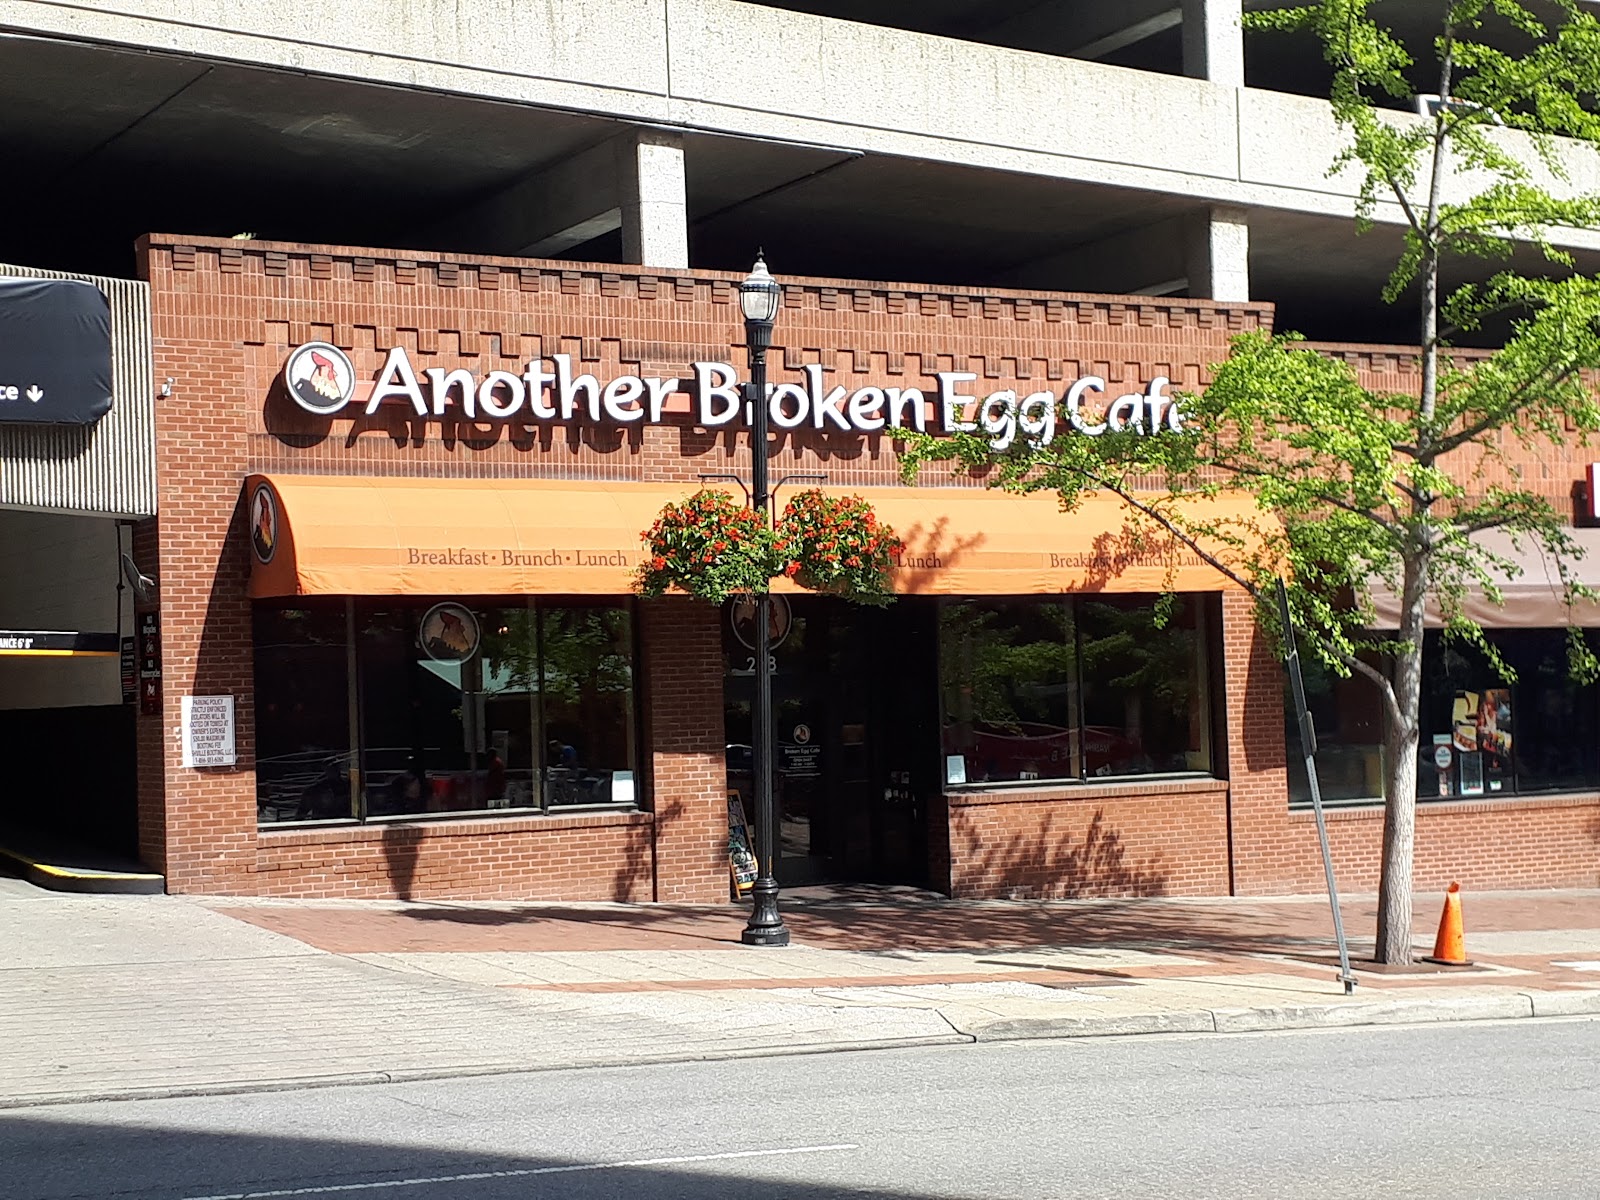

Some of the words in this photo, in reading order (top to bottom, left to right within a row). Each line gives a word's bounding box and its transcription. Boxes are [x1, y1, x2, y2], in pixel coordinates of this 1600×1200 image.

[365, 346, 679, 423] Another
[936, 372, 1055, 450] Egg
[407, 548, 488, 566] Breakfast
[501, 549, 562, 567] Brunch
[575, 549, 628, 567] Lunch
[894, 552, 942, 569] Lunch
